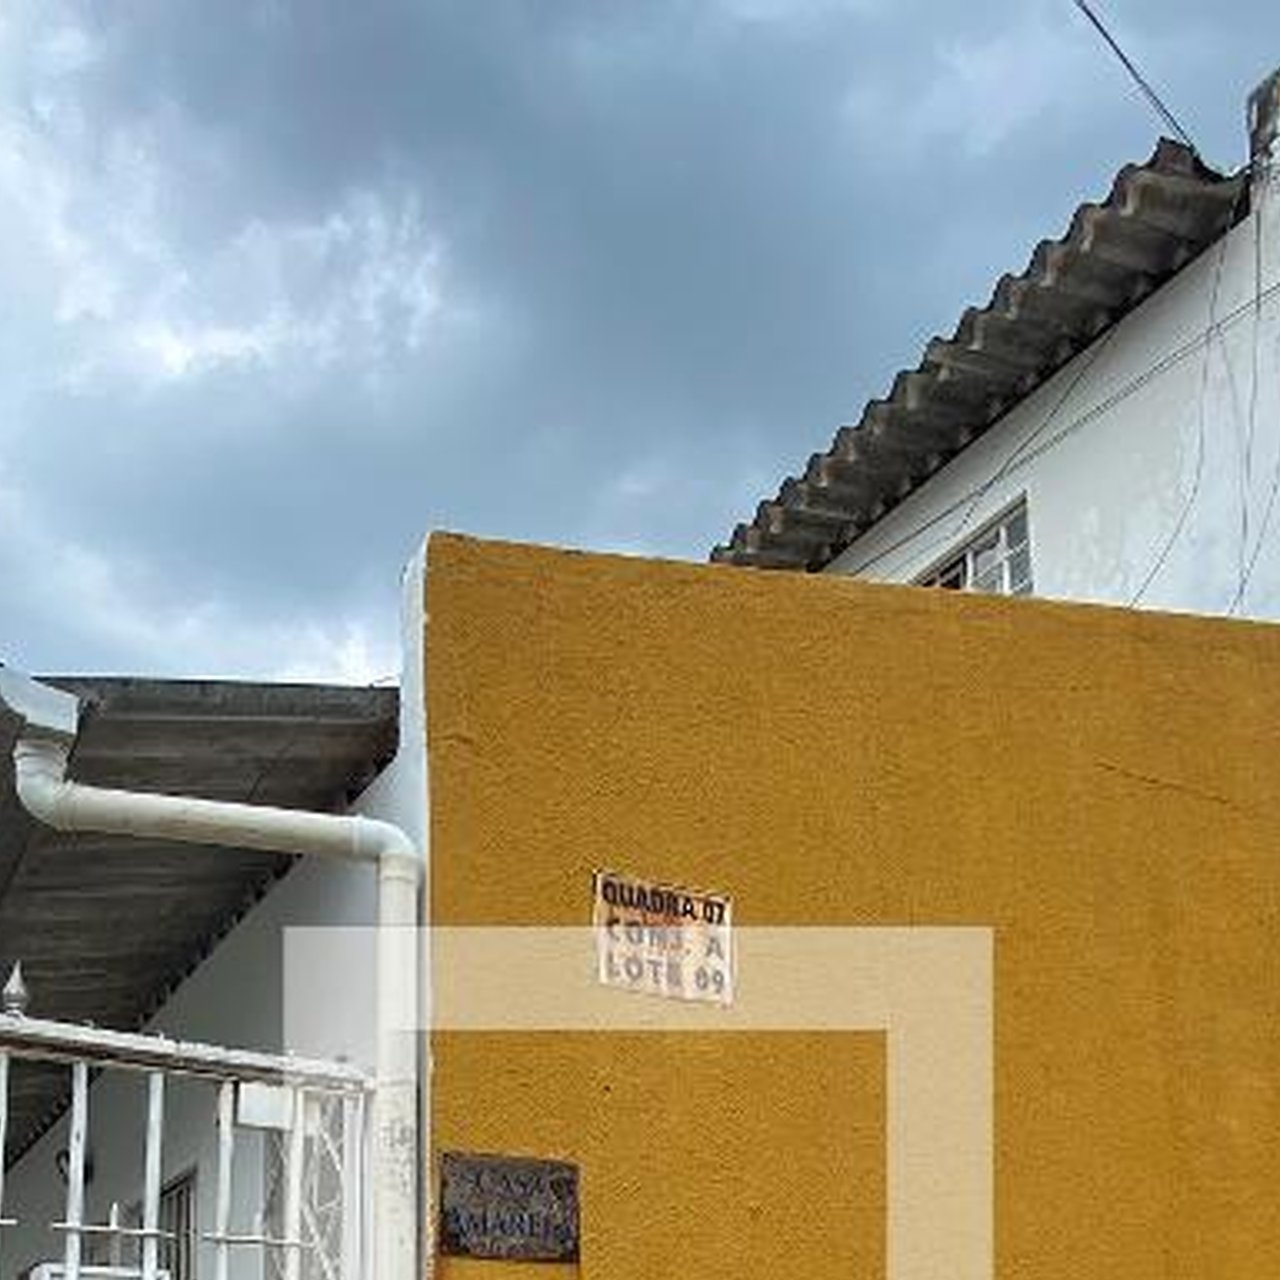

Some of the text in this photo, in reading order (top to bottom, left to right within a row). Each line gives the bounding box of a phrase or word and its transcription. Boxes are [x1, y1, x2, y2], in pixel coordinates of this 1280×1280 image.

[601, 879, 725, 926] QUADRA 07
[705, 936, 725, 961] A
[607, 951, 725, 995] LOTE 09
